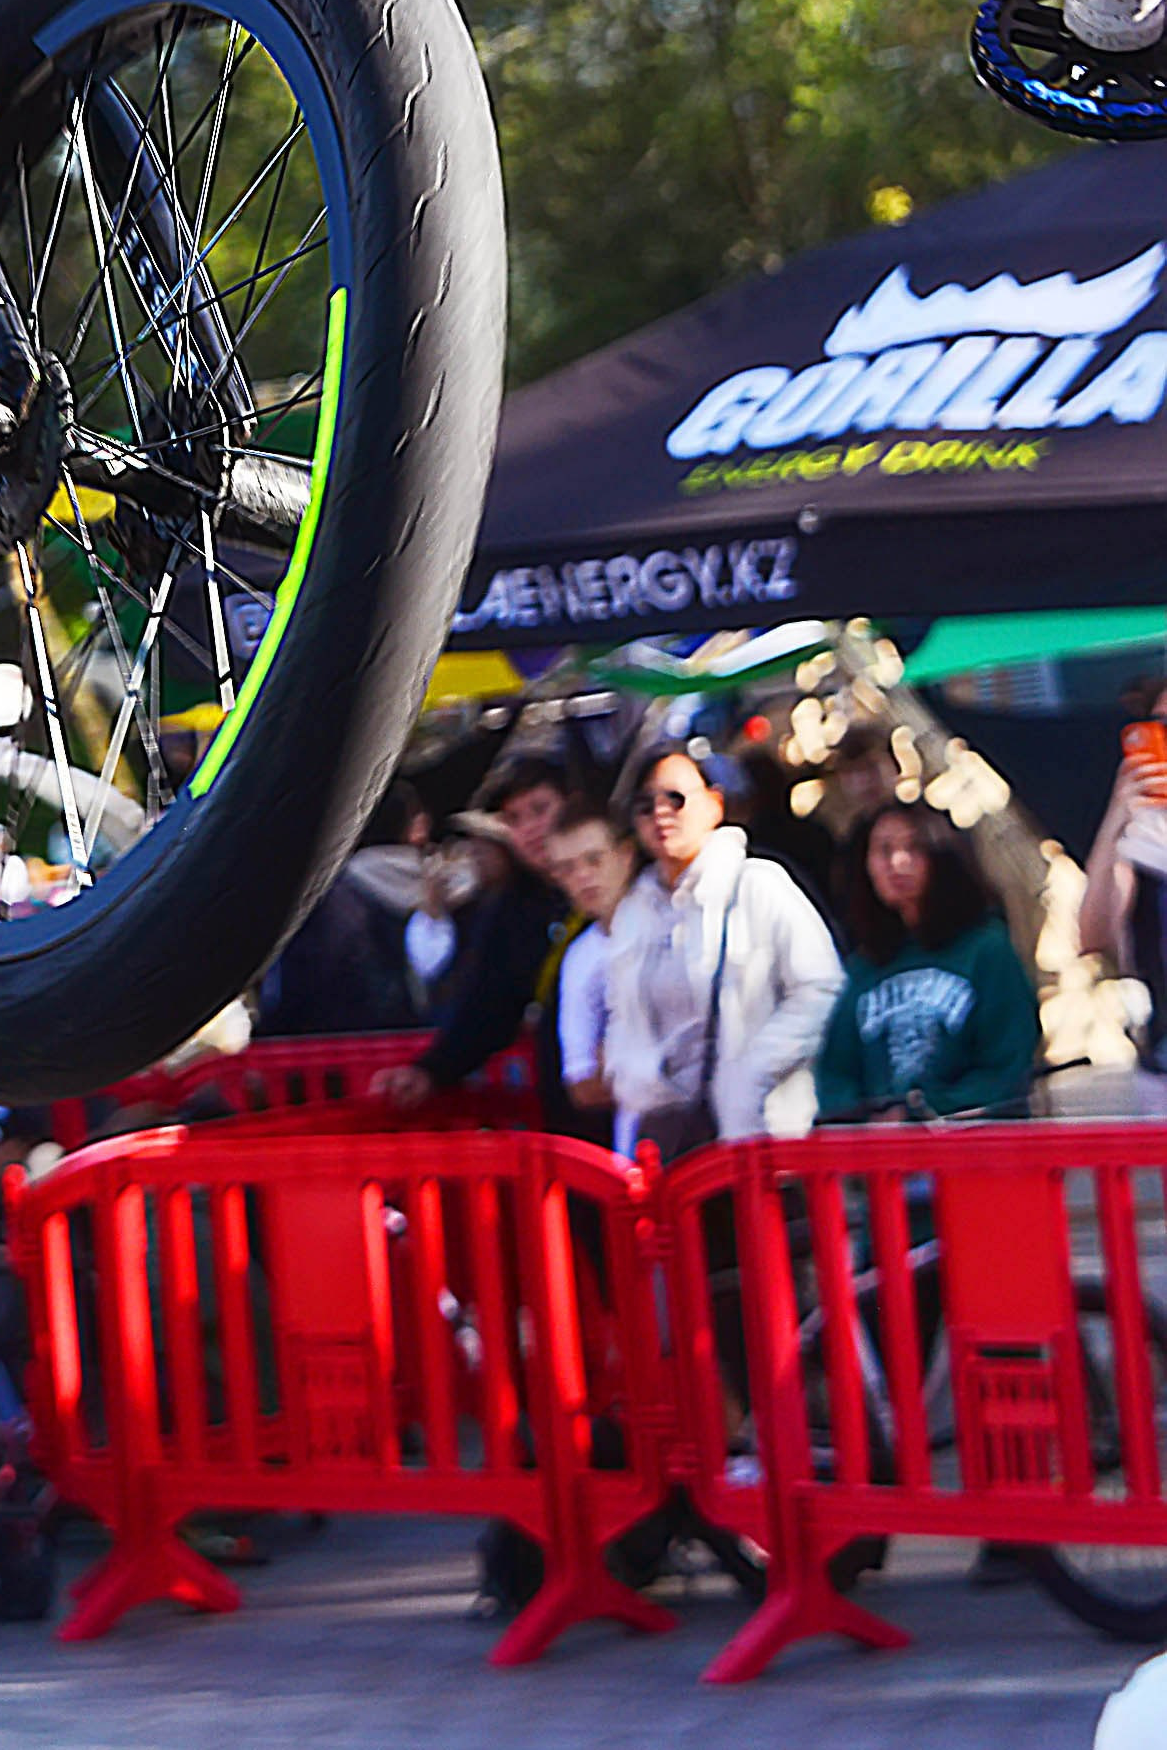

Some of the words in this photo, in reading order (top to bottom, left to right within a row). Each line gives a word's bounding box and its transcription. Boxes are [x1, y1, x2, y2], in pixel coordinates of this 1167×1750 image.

[667, 331, 1167, 459] GORILLA
[676, 442, 881, 497] ENERGY
[879, 436, 1047, 477] DRINK
[452, 536, 797, 633] AENERGY.KZ
